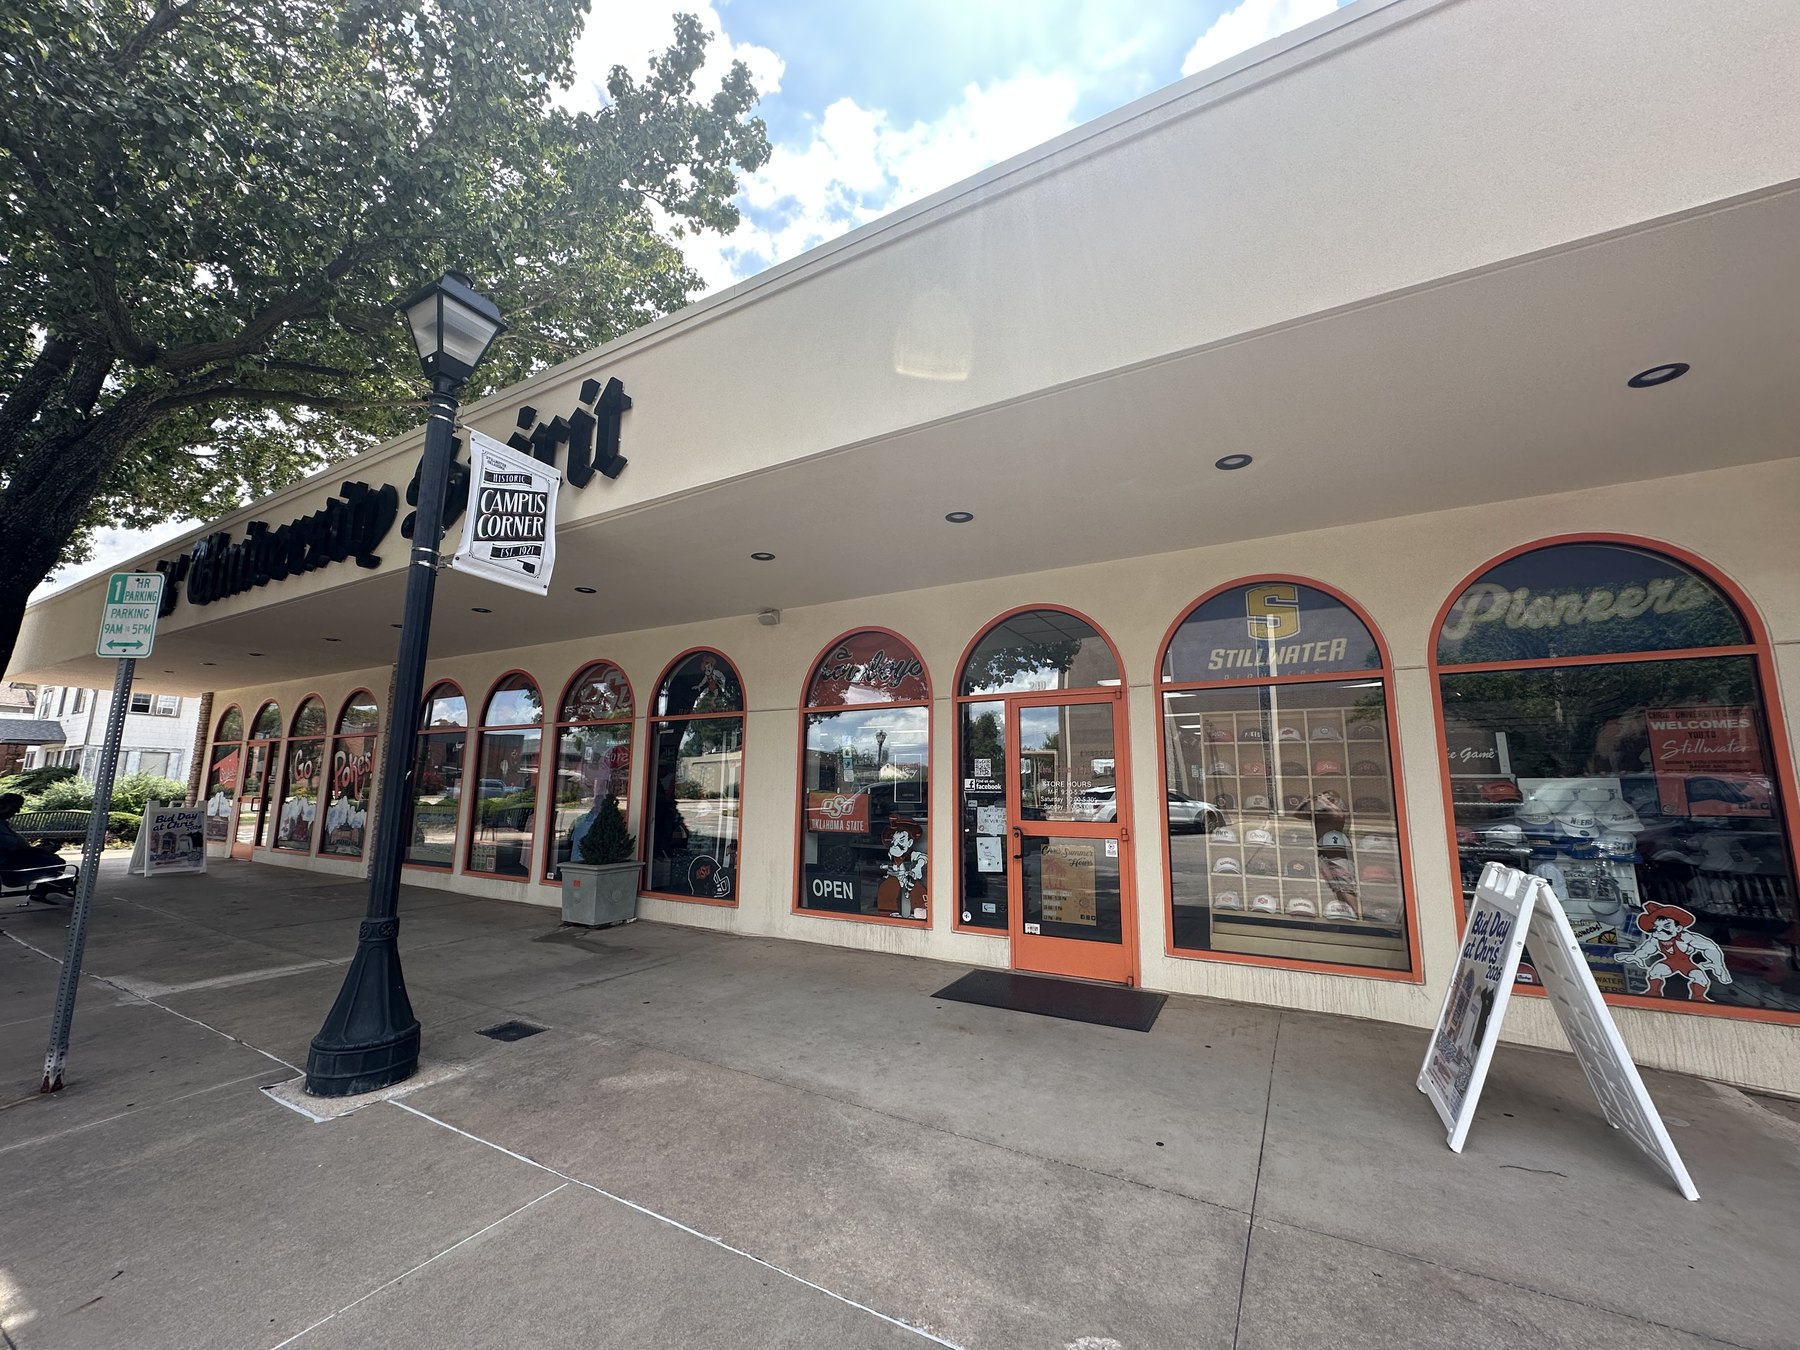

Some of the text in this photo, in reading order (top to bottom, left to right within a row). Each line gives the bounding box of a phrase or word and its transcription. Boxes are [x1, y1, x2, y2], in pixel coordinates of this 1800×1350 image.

[401, 376, 632, 541] Sirit
[492, 473, 525, 484] HISTORIC
[480, 489, 546, 514] CAMPUS
[477, 513, 544, 539] CORNER
[500, 545, 535, 558] EST. 1921
[114, 580, 122, 601] 1
[137, 578, 150, 589] HR
[124, 590, 158, 602] PARKING
[110, 608, 150, 619] PARKING
[1245, 584, 1301, 641] S
[104, 623, 123, 634] 9AM
[131, 624, 151, 635] 5PM
[1207, 637, 1348, 671] STILLWATER
[1650, 719, 1750, 730] WELCOMES
[1687, 731, 1703, 739] YOU
[1460, 746, 1495, 763] Game
[1659, 738, 1749, 759] Stillwater
[294, 750, 313, 781] Go
[1042, 780, 1092, 788] STORE HOURS
[152, 820, 195, 832] at Chris
[155, 812, 198, 824] Bid Day
[845, 820, 864, 831] STATE
[1060, 847, 1093, 858] Summer
[812, 878, 854, 900] OPEN
[1471, 910, 1512, 945] Bid Day
[1574, 920, 1603, 939] ioneers!
[1463, 935, 1500, 965] at Chris
[1485, 964, 1503, 982] 2026
